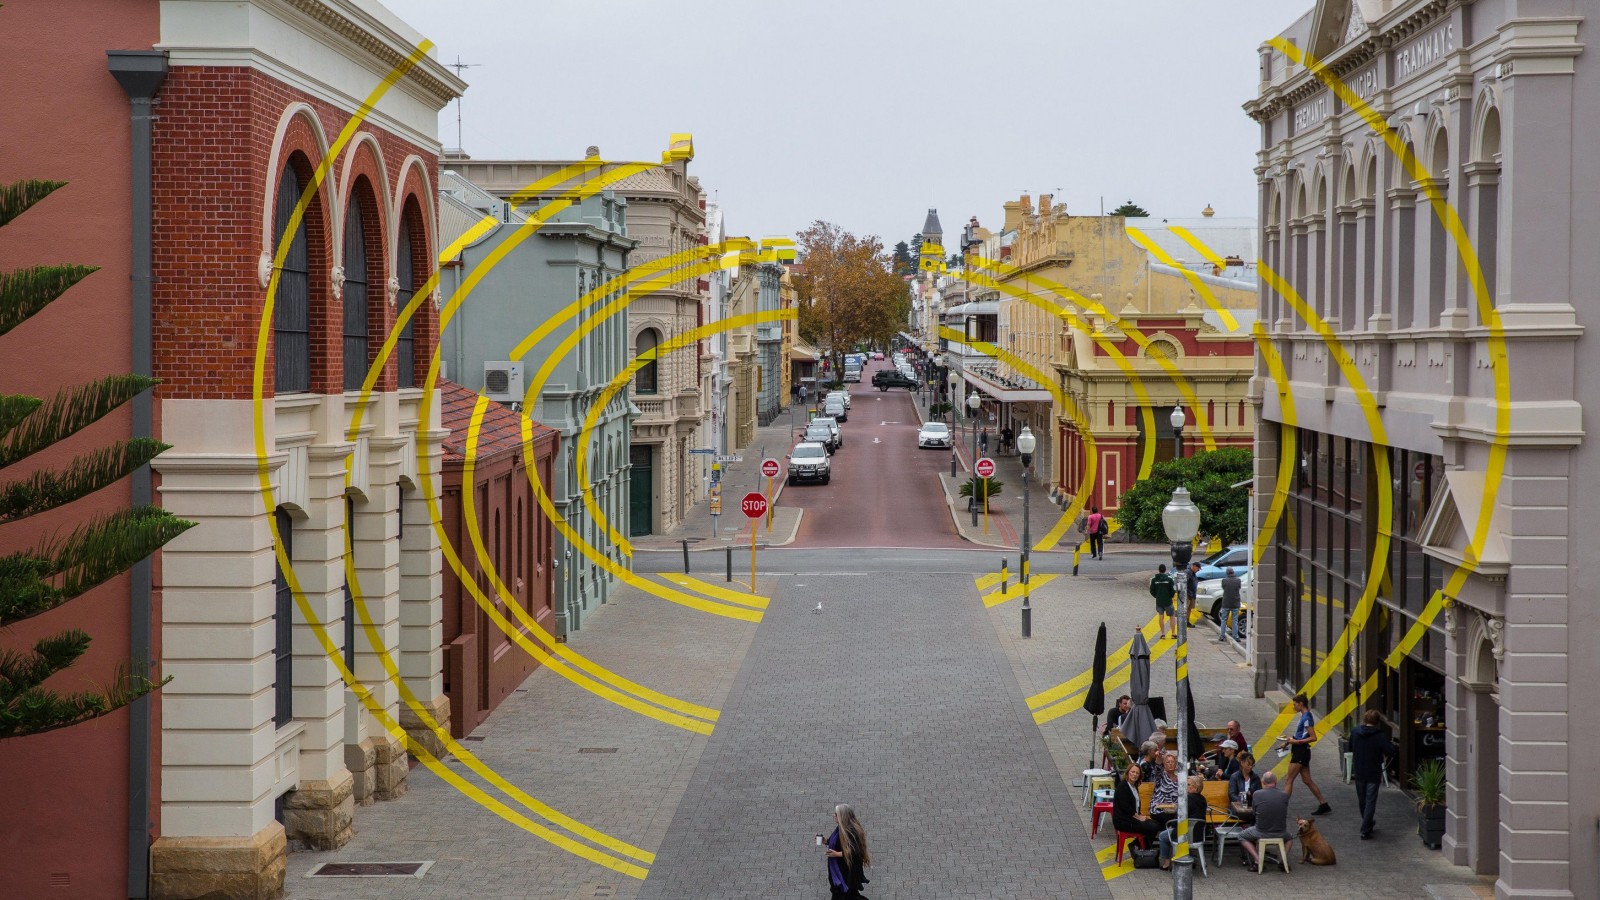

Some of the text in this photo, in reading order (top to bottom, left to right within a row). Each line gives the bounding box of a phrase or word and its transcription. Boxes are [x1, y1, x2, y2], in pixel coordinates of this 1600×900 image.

[1295, 23, 1454, 132] FREMANTL MUNICIPA TRAMWAYS
[743, 501, 766, 511] STOP
